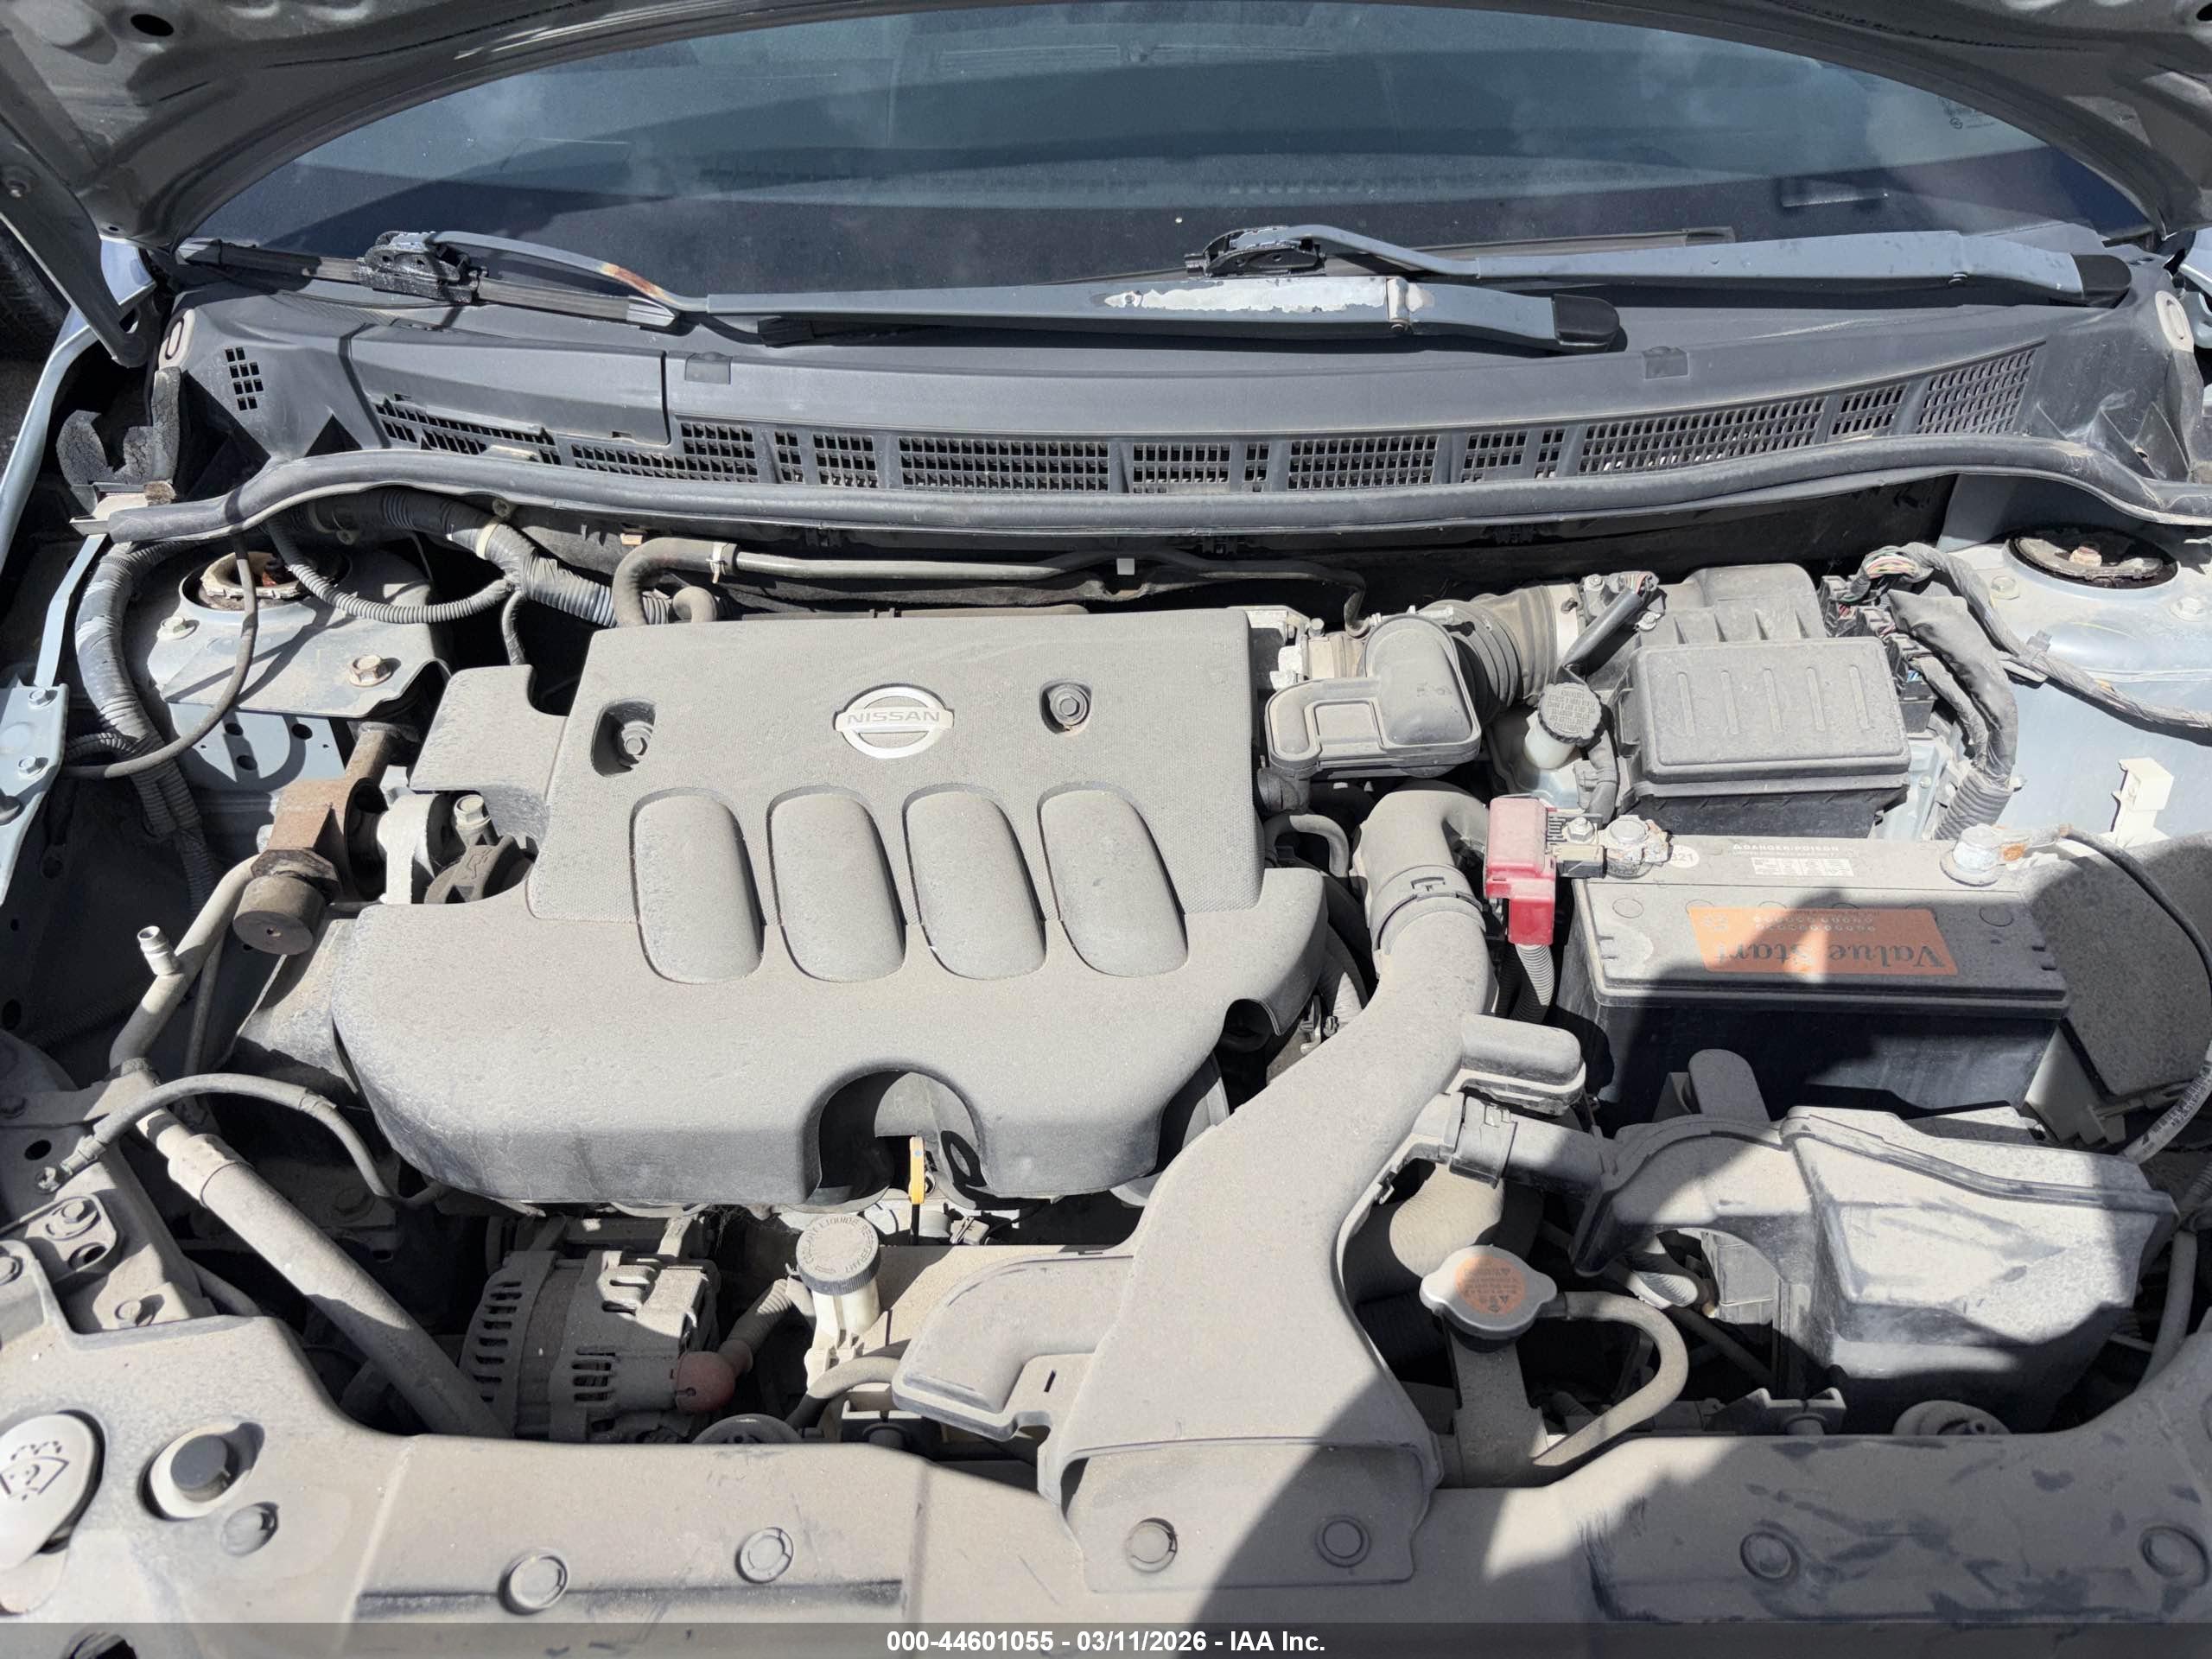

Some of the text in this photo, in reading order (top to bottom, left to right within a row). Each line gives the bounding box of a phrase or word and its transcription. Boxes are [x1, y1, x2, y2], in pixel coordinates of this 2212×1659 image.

[847, 710, 940, 725] NISSAN
[1715, 942, 1945, 969] Value Start
